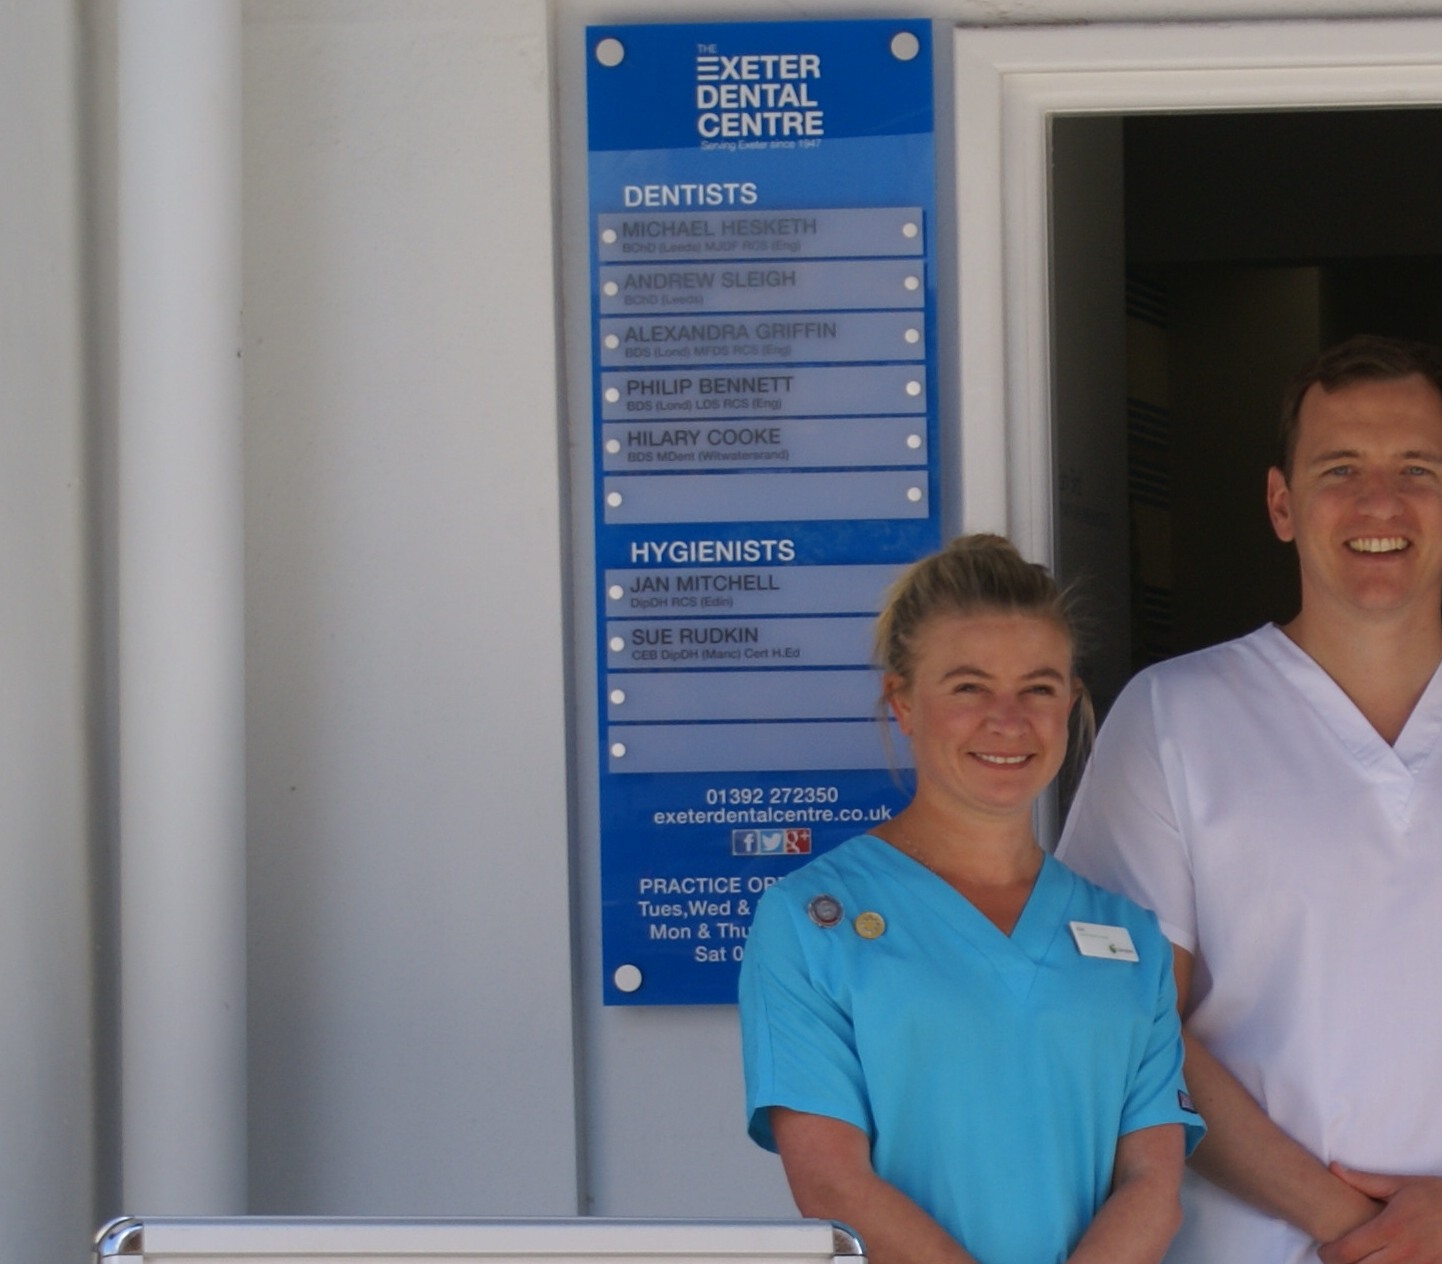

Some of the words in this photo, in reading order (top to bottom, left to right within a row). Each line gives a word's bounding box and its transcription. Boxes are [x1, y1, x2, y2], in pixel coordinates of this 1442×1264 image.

[697, 44, 717, 54] THE
[697, 54, 821, 81] EXETER
[697, 83, 818, 109] DENTAL
[698, 111, 824, 138] CENTRE
[701, 140, 736, 151] Serving
[738, 140, 768, 149] Exeter
[770, 139, 795, 148] since
[799, 138, 821, 148] 1947
[624, 182, 758, 207] DENTISTS
[622, 219, 715, 238] MICHAEL
[721, 218, 817, 236] HESKETH
[624, 272, 715, 290] ANDREW
[721, 271, 796, 288] SLEIGH
[625, 324, 749, 342] ALEXANDRA
[756, 322, 837, 339] GRIFFIN
[627, 378, 692, 395] PHILIP
[699, 376, 794, 394] BENNETT
[627, 401, 652, 411] BDS
[723, 399, 749, 409] RCS
[752, 398, 782, 410] (Eng)
[628, 430, 700, 446] HILARY
[708, 428, 781, 445] COOKE
[628, 452, 654, 463] BDS
[631, 540, 795, 563] HYGIENISTS
[630, 576, 670, 593] JAN
[676, 574, 780, 591] MITCHELL
[631, 598, 667, 609] DipDH
[672, 597, 697, 607] RCS
[701, 597, 733, 609] (Edin)
[632, 629, 672, 645] SUE
[680, 627, 758, 644] RUDKIN
[661, 650, 698, 661] DipDH
[744, 649, 768, 659] Cert
[706, 788, 763, 805] 01392
[770, 787, 838, 803] 272350
[654, 805, 892, 825] exeterdentalcentre.co.uk
[640, 877, 742, 894] PRACTICE
[638, 900, 730, 919] Tues,Wed
[737, 899, 751, 916] &
[650, 924, 691, 939] Mon
[698, 923, 711, 939] &
[695, 946, 726, 962] Sat
